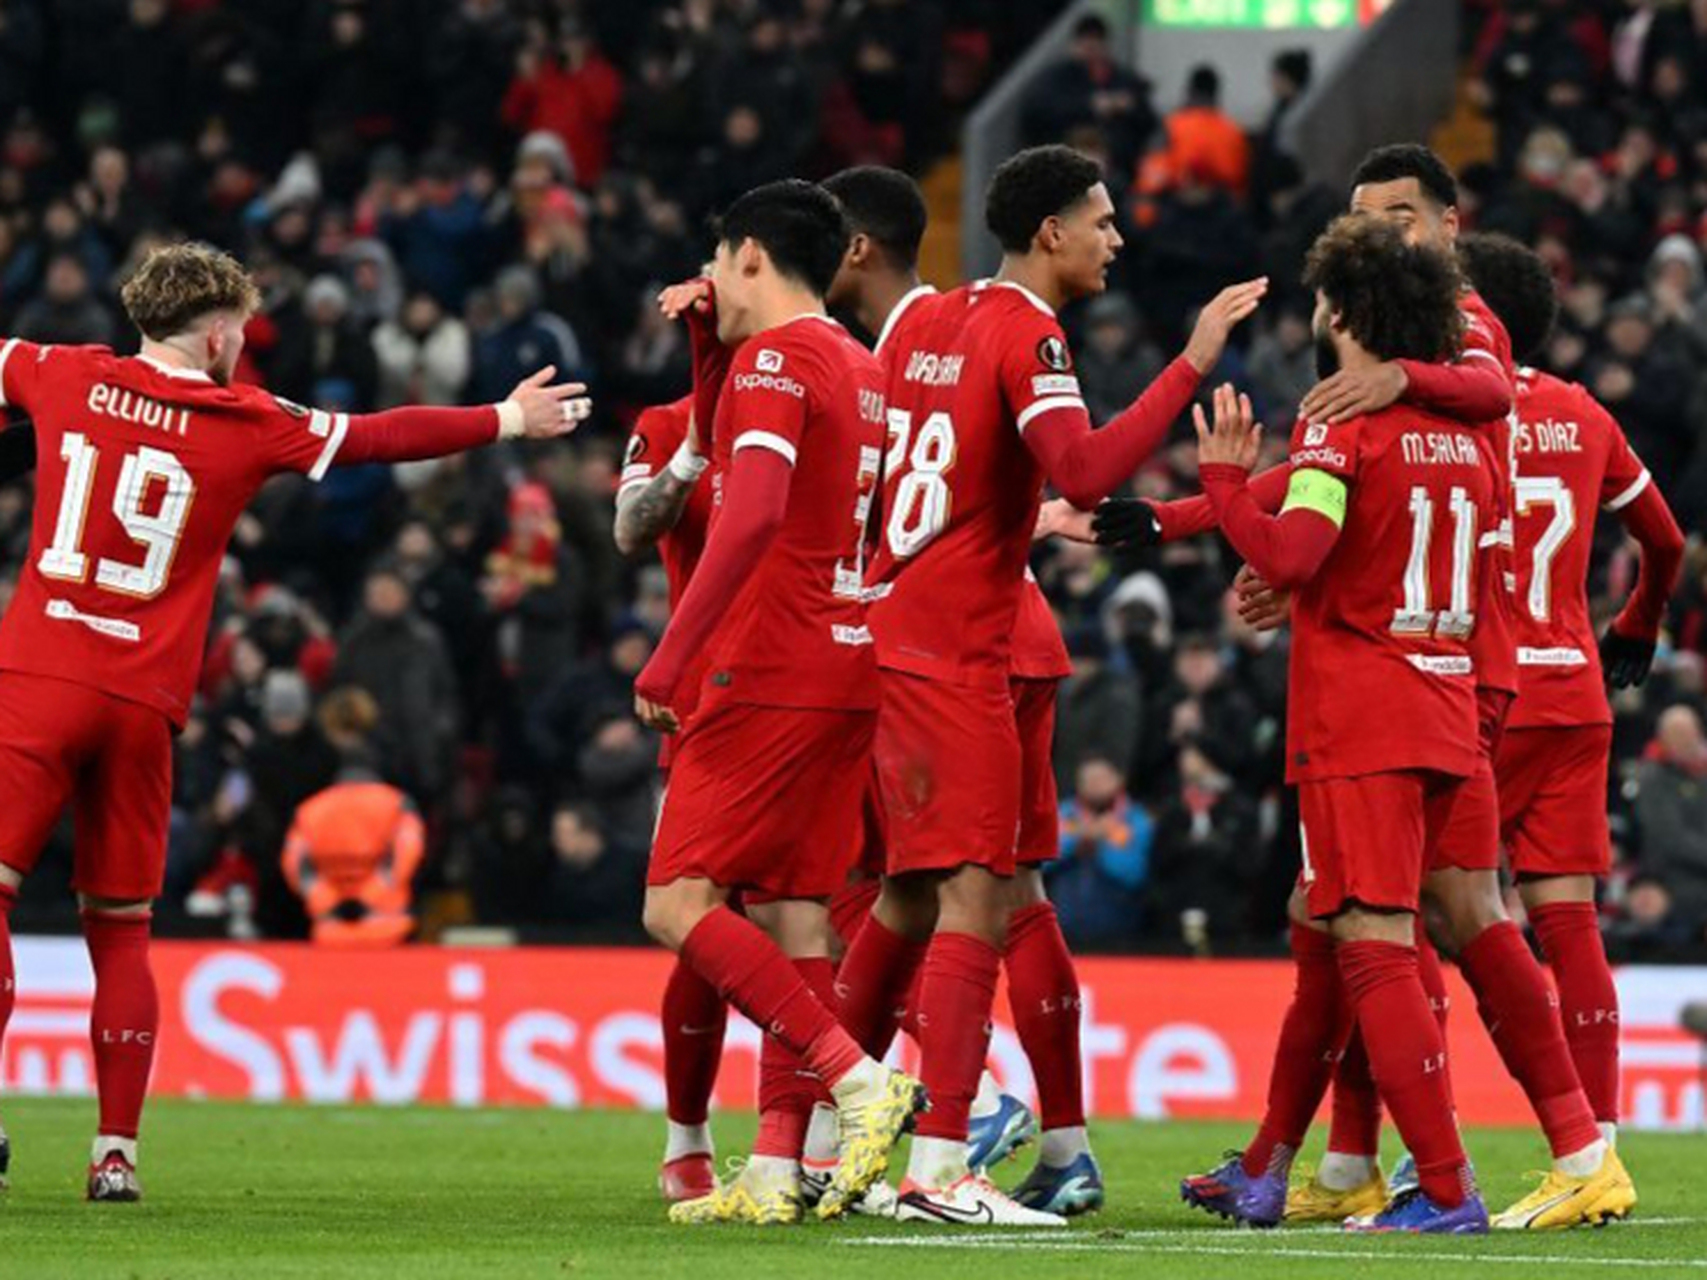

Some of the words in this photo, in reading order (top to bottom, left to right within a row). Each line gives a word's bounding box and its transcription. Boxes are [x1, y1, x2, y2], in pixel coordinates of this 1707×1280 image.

[884, 407, 957, 561] 78
[1534, 418, 1583, 453] DÍAZ
[37, 431, 196, 599] 19
[1389, 485, 1478, 642] 11
[1514, 475, 1576, 623] 7
[179, 948, 1238, 1119] Swisste
